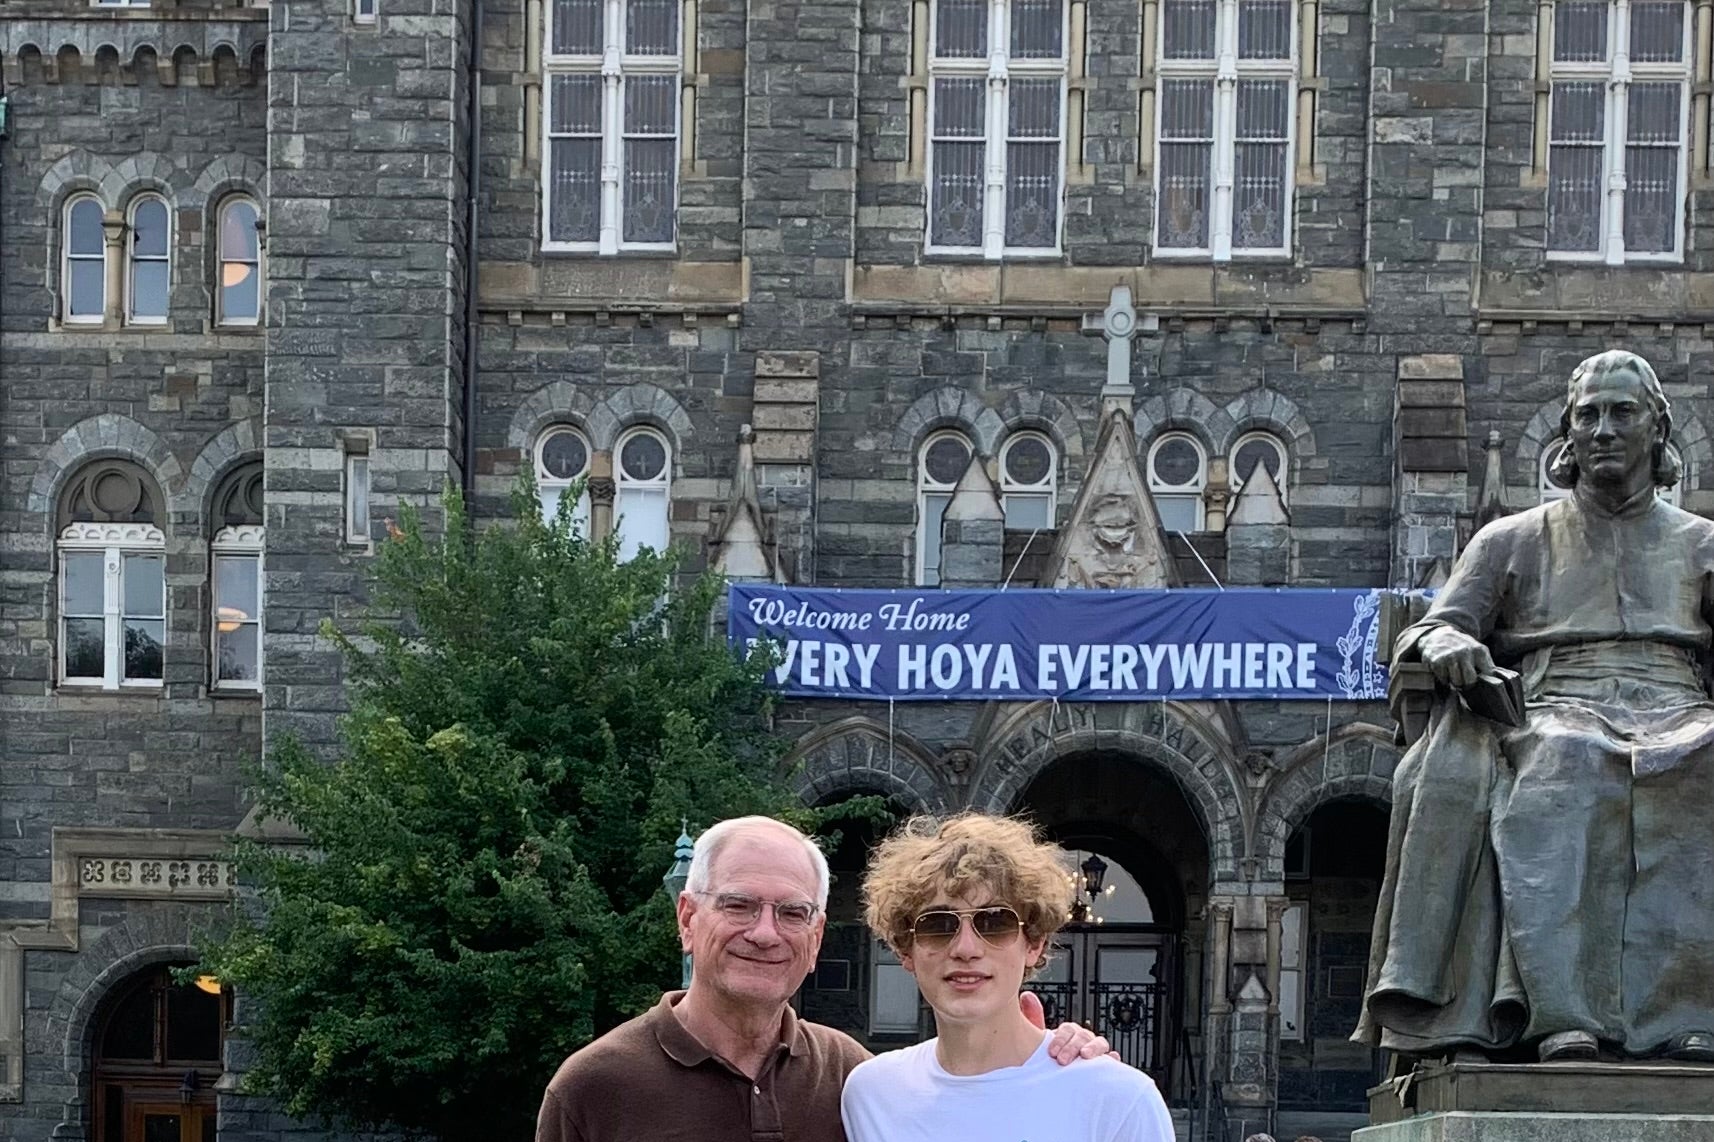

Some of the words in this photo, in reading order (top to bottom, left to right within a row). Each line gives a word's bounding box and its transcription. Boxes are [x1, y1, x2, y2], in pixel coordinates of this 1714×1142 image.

[748, 597, 873, 631] Welcome
[878, 597, 971, 632] Home
[897, 642, 1021, 691] HOYA
[1037, 642, 1318, 691] EVERYWHERE
